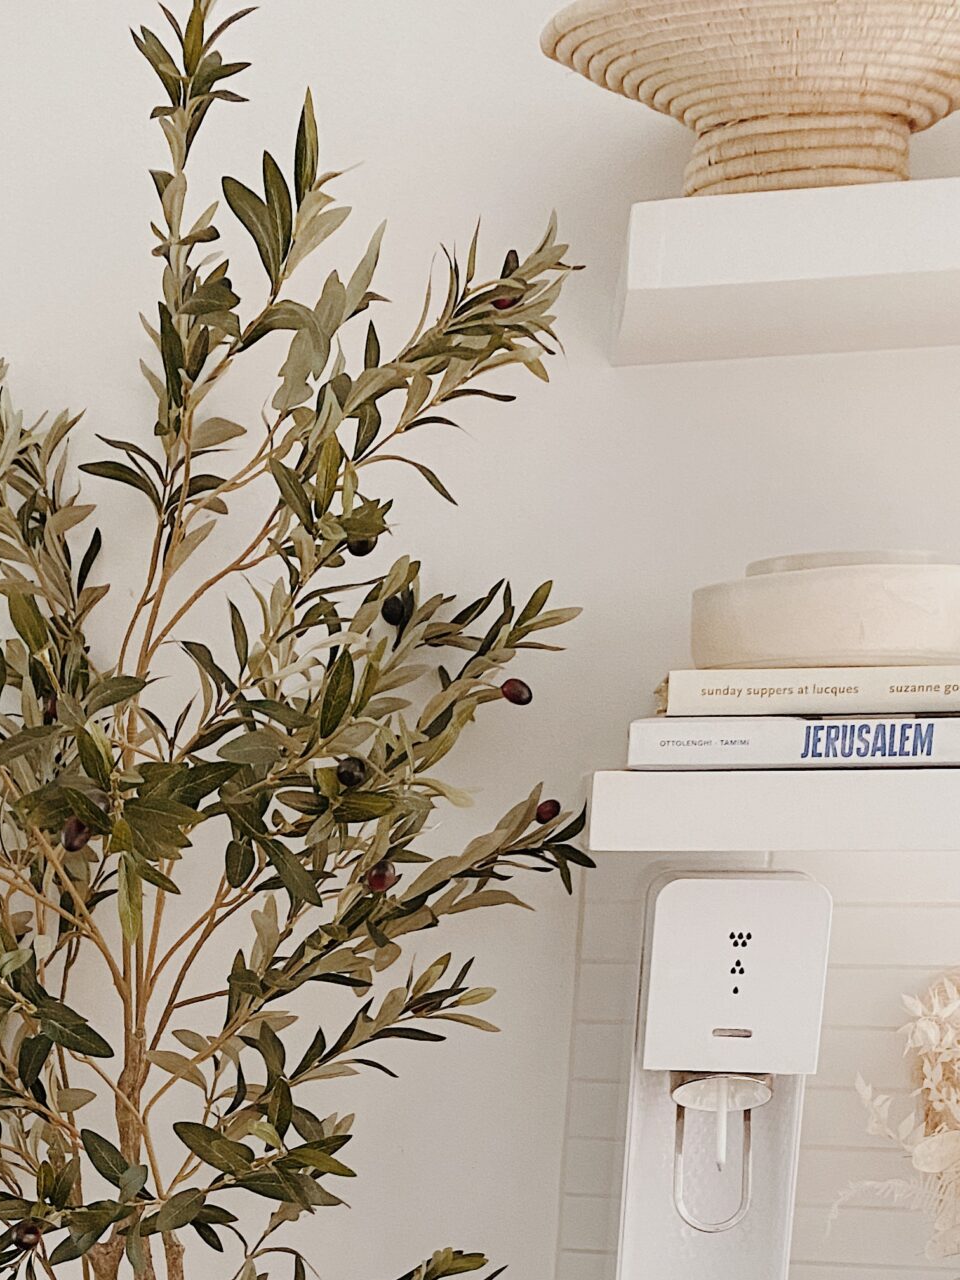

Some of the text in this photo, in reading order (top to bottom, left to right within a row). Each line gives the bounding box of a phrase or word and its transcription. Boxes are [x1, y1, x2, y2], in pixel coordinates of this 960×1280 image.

[701, 683, 859, 698] sunday suppers at lucques
[889, 684, 941, 694] suzanne
[659, 739, 712, 747] OTTOLENGHI
[801, 723, 935, 758] JERUSALEM
